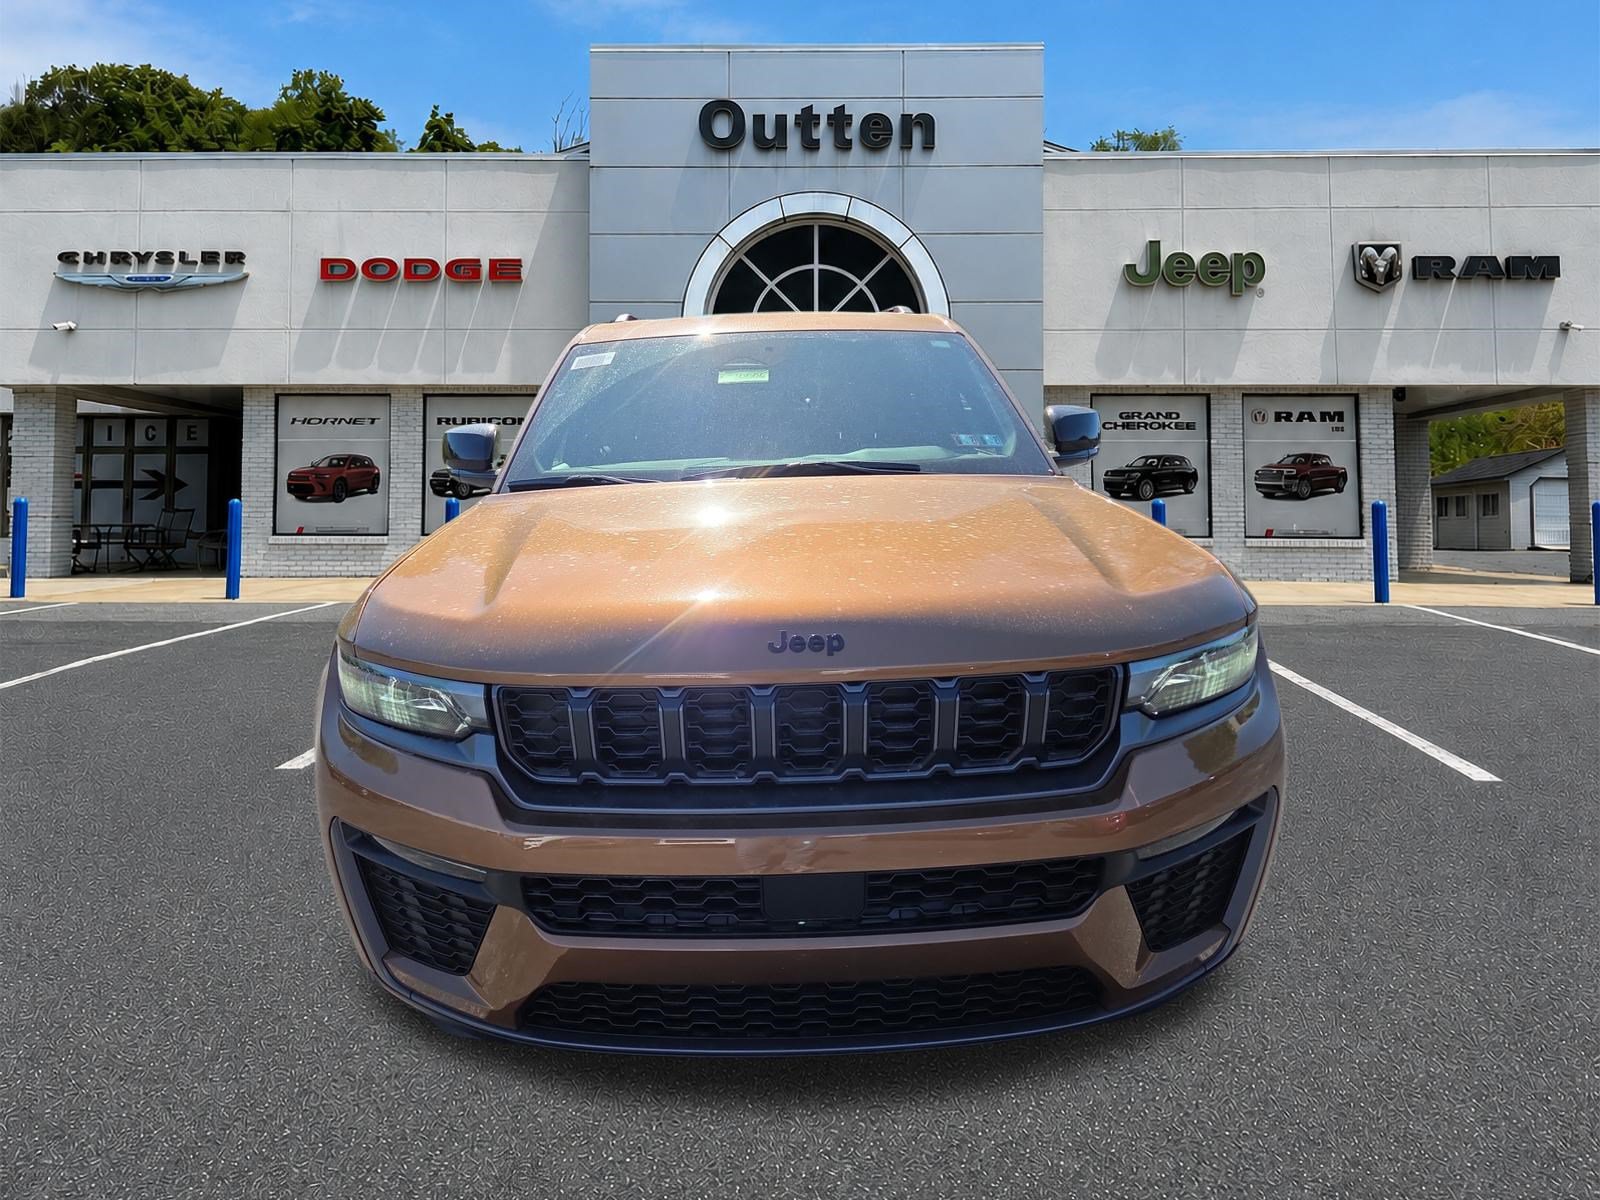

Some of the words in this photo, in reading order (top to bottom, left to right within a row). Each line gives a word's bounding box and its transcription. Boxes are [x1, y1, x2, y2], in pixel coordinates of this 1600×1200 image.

[698, 99, 936, 150] Outten
[57, 250, 247, 266] CHRYSLER
[1123, 240, 1266, 296] Jeep
[1411, 255, 1561, 280] RAM
[320, 257, 523, 282] DODGE
[290, 417, 381, 425] HORNET
[1118, 411, 1181, 420] GRAND
[1274, 410, 1345, 423] RAM
[1101, 421, 1197, 431] CHEROKEE
[767, 630, 845, 656] Jeep
